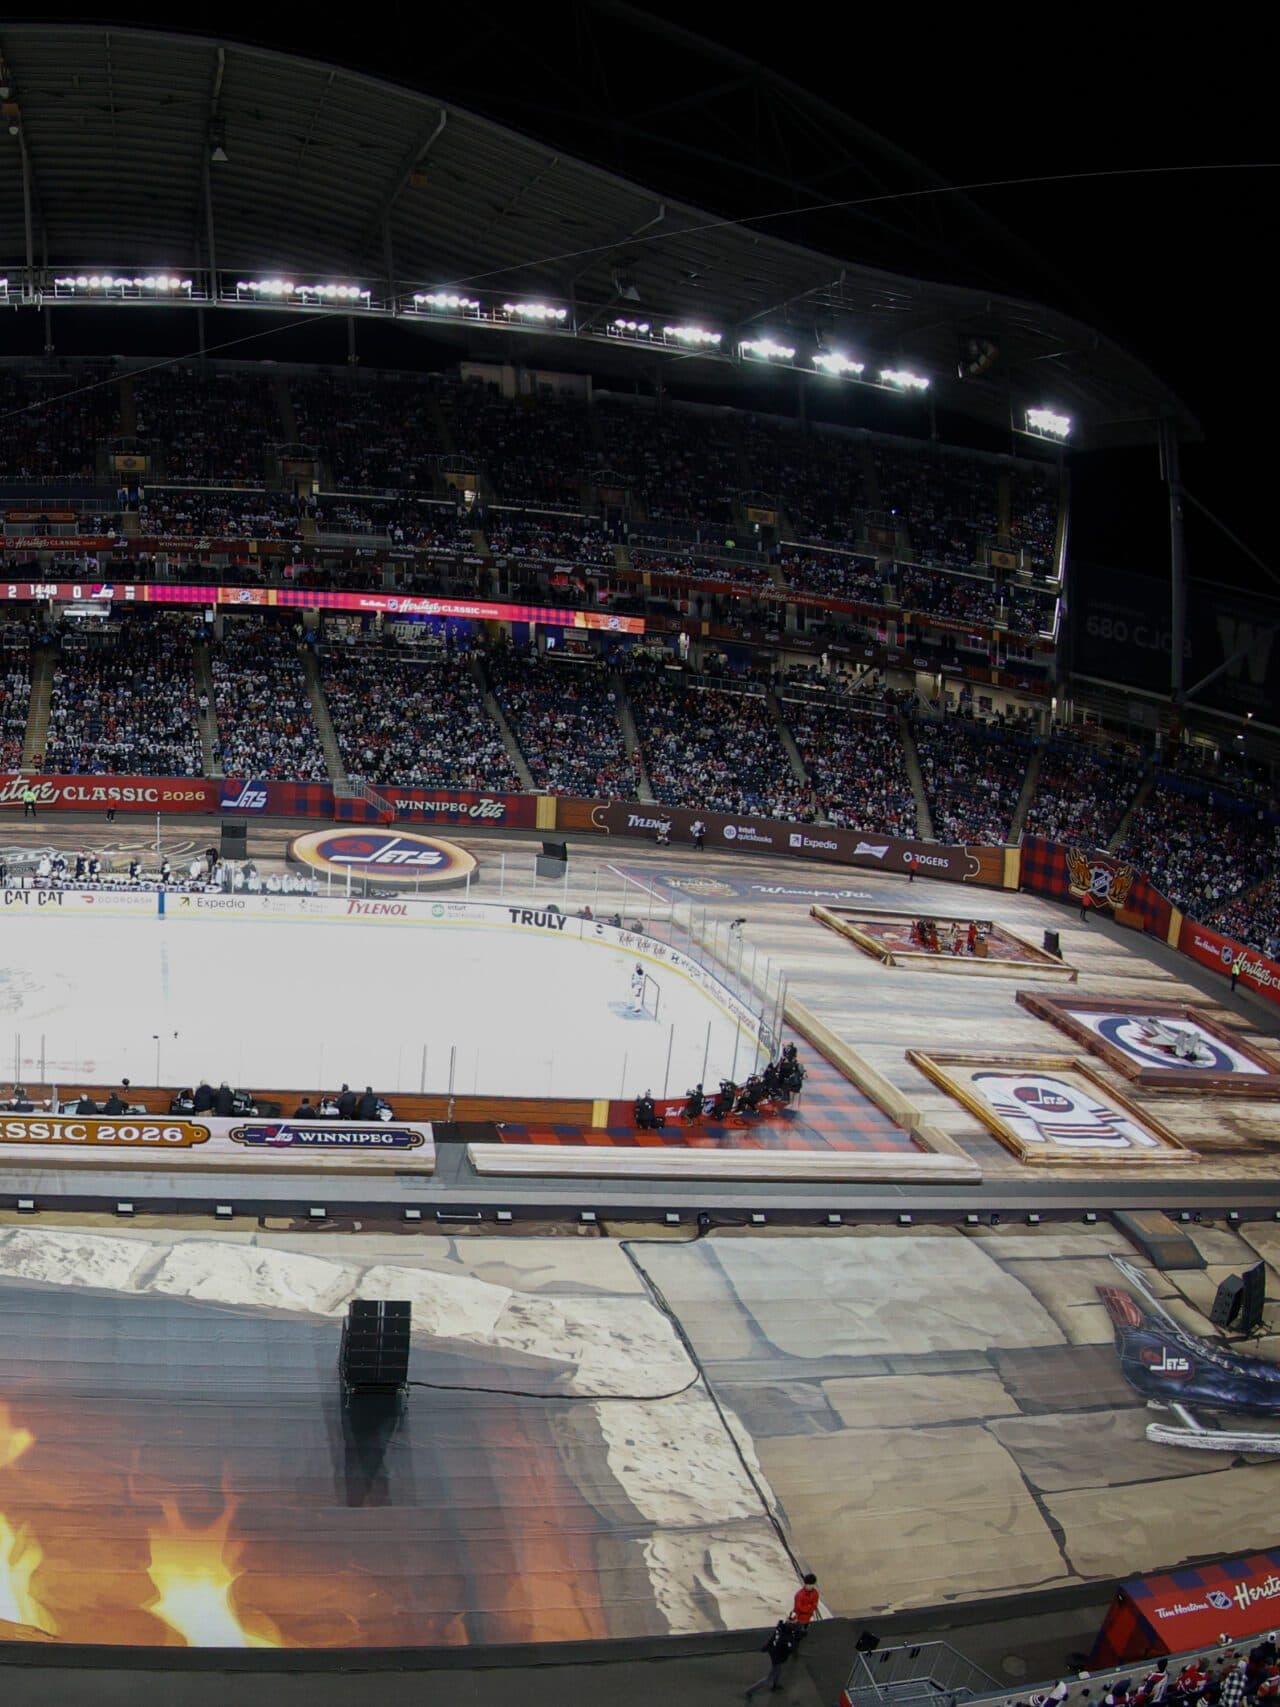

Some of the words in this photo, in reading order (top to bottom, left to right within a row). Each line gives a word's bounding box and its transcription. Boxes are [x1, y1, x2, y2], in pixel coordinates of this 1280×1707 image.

[8, 585, 17, 598] 2
[73, 585, 81, 598] 0
[399, 598, 442, 614] Heritage
[442, 604, 480, 615] CLASSIC
[1086, 615, 1128, 642] 680
[62, 786, 159, 802] CLASSIC
[162, 791, 206, 801] 2026
[395, 799, 468, 813] WINNIPEG
[469, 798, 507, 819] Jets
[803, 837, 838, 850] Expedia
[4, 890, 31, 905] CAT
[38, 891, 65, 906] CAT
[197, 898, 246, 909] Expedia
[347, 900, 409, 916] TYLENOL
[508, 908, 567, 931] TRULY
[1233, 951, 1272, 987] Heritage
[96, 1125, 184, 1142] 2026
[299, 1131, 394, 1145] WINNIPEG
[1149, 1346, 1189, 1371] JETS
[1155, 1607, 1175, 1619] Tim
[1173, 1602, 1209, 1615] Hortons
